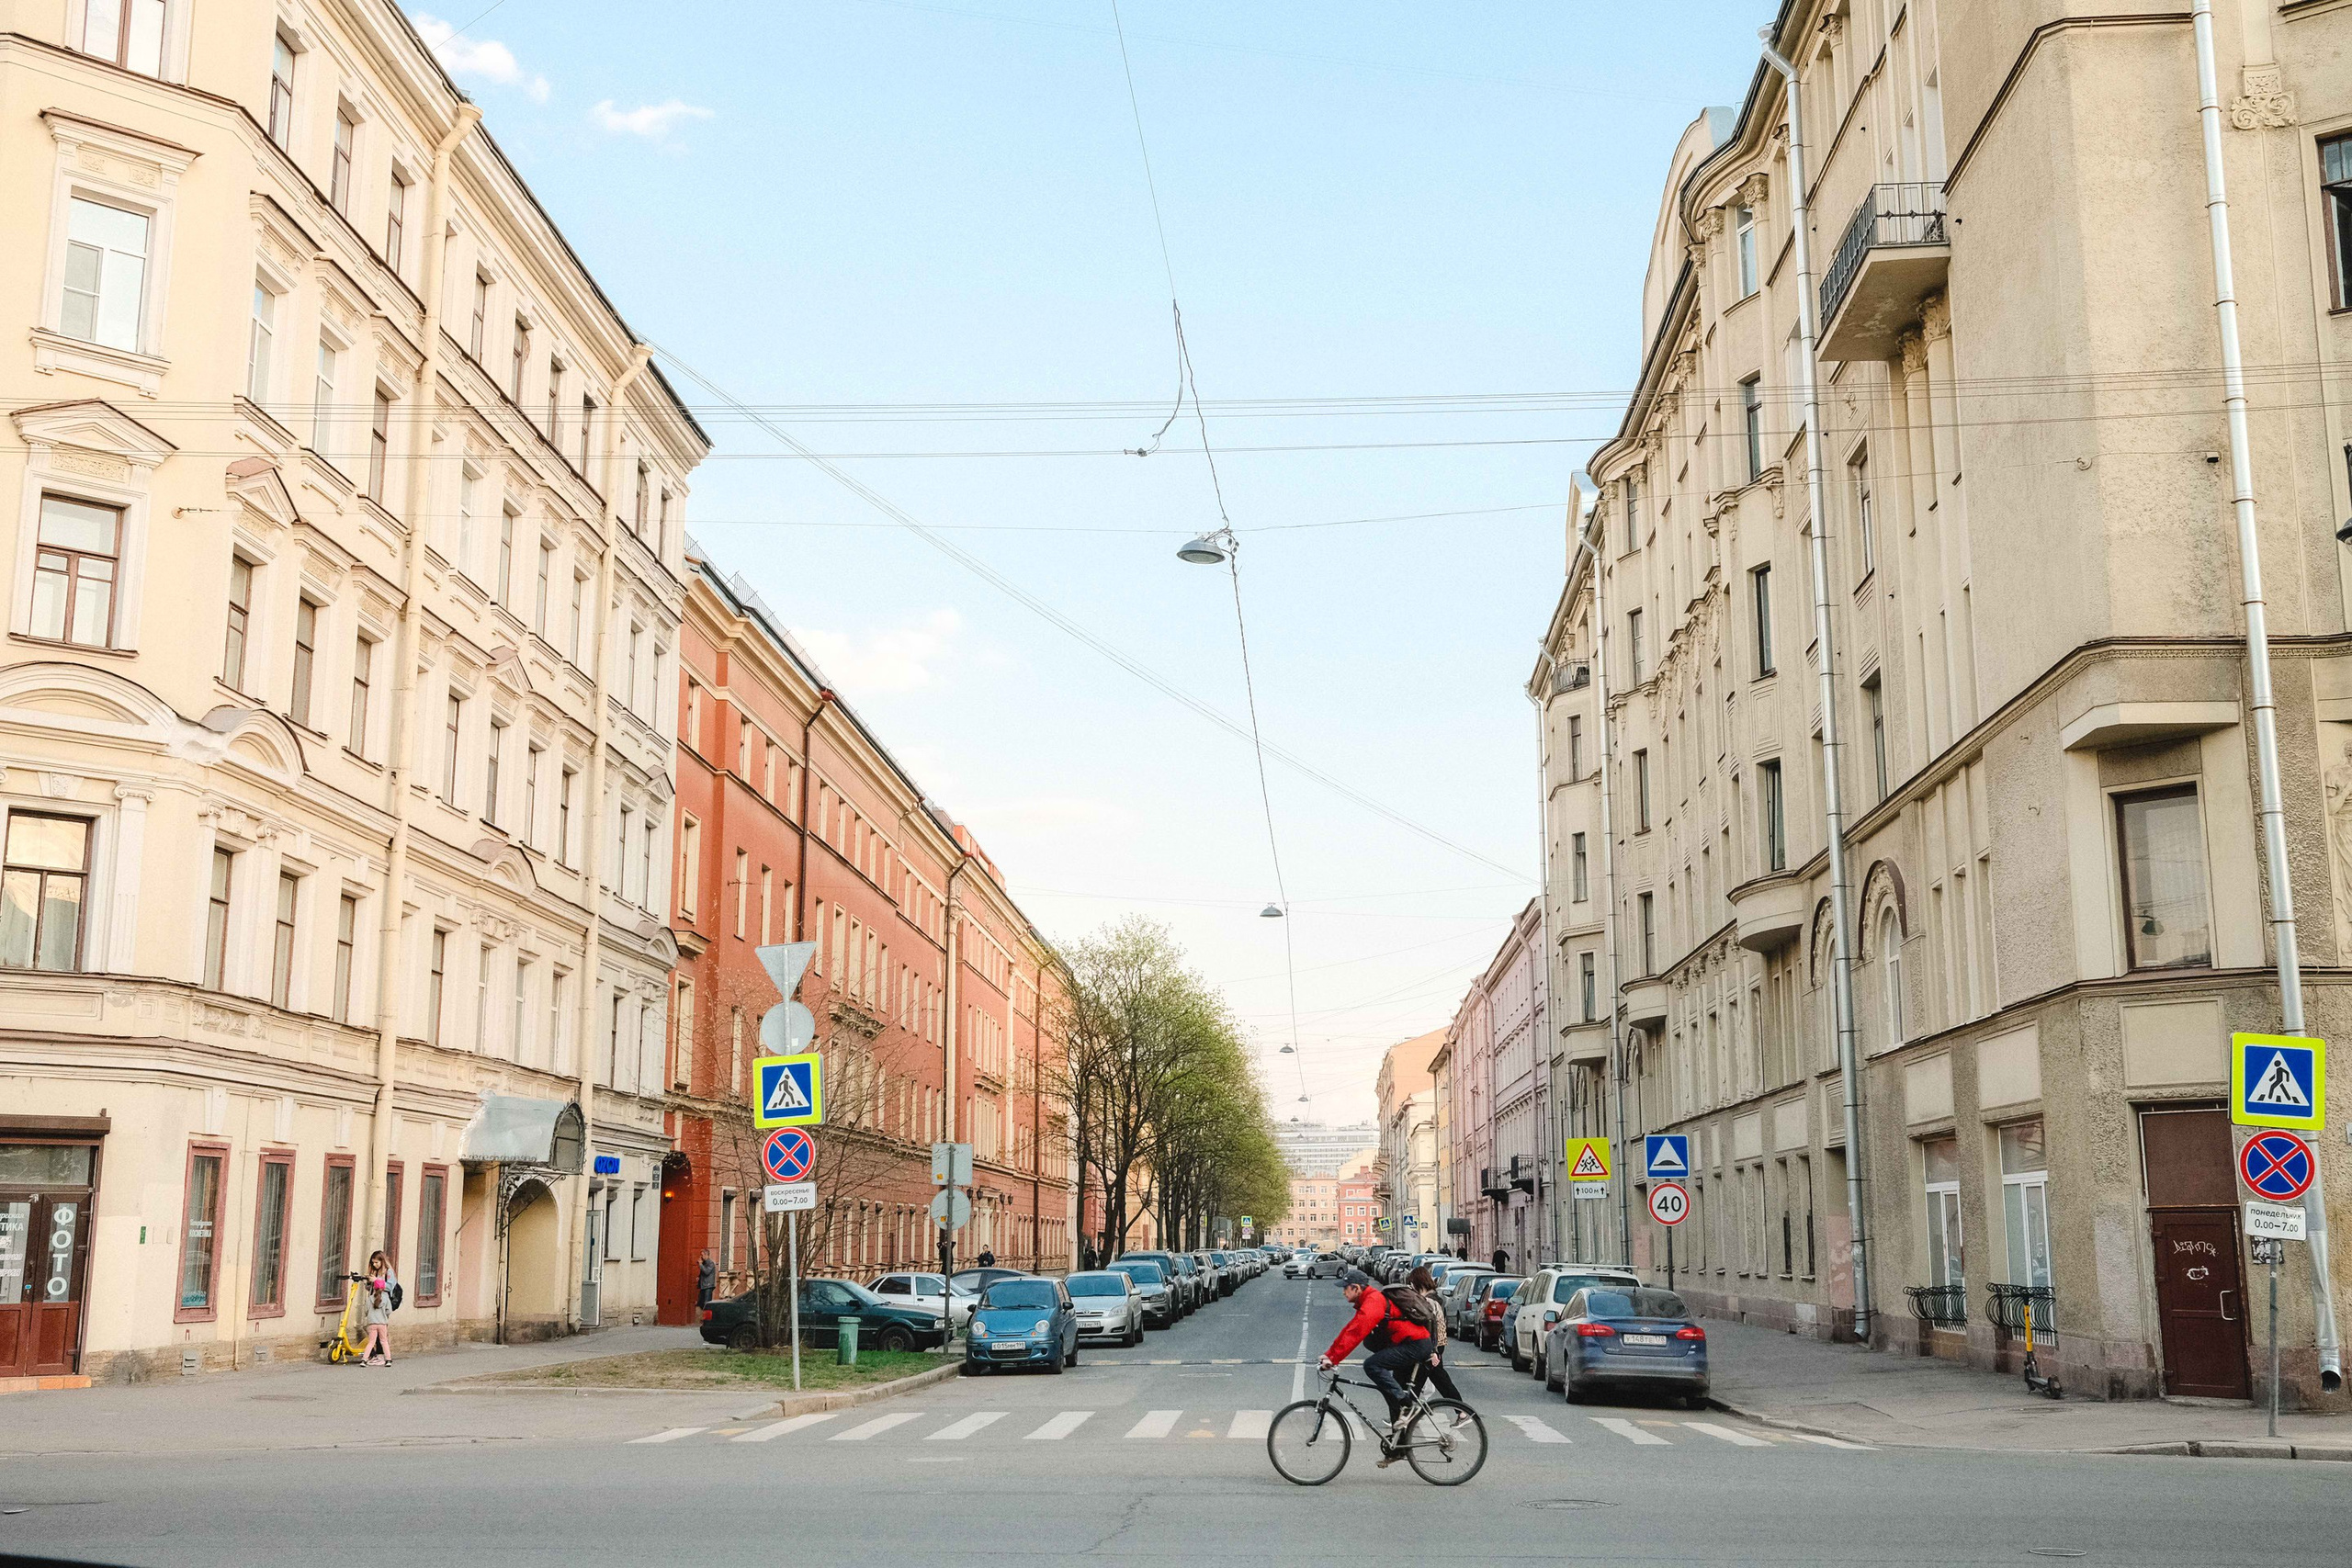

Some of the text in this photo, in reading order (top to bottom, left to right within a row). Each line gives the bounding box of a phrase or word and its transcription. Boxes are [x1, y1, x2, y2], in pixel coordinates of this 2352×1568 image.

[594, 1156, 620, 1174] OZON
[1657, 1195, 1682, 1213] 40
[2250, 1208, 2301, 1220] понедельник
[47, 1206, 74, 1296] ФОТО
